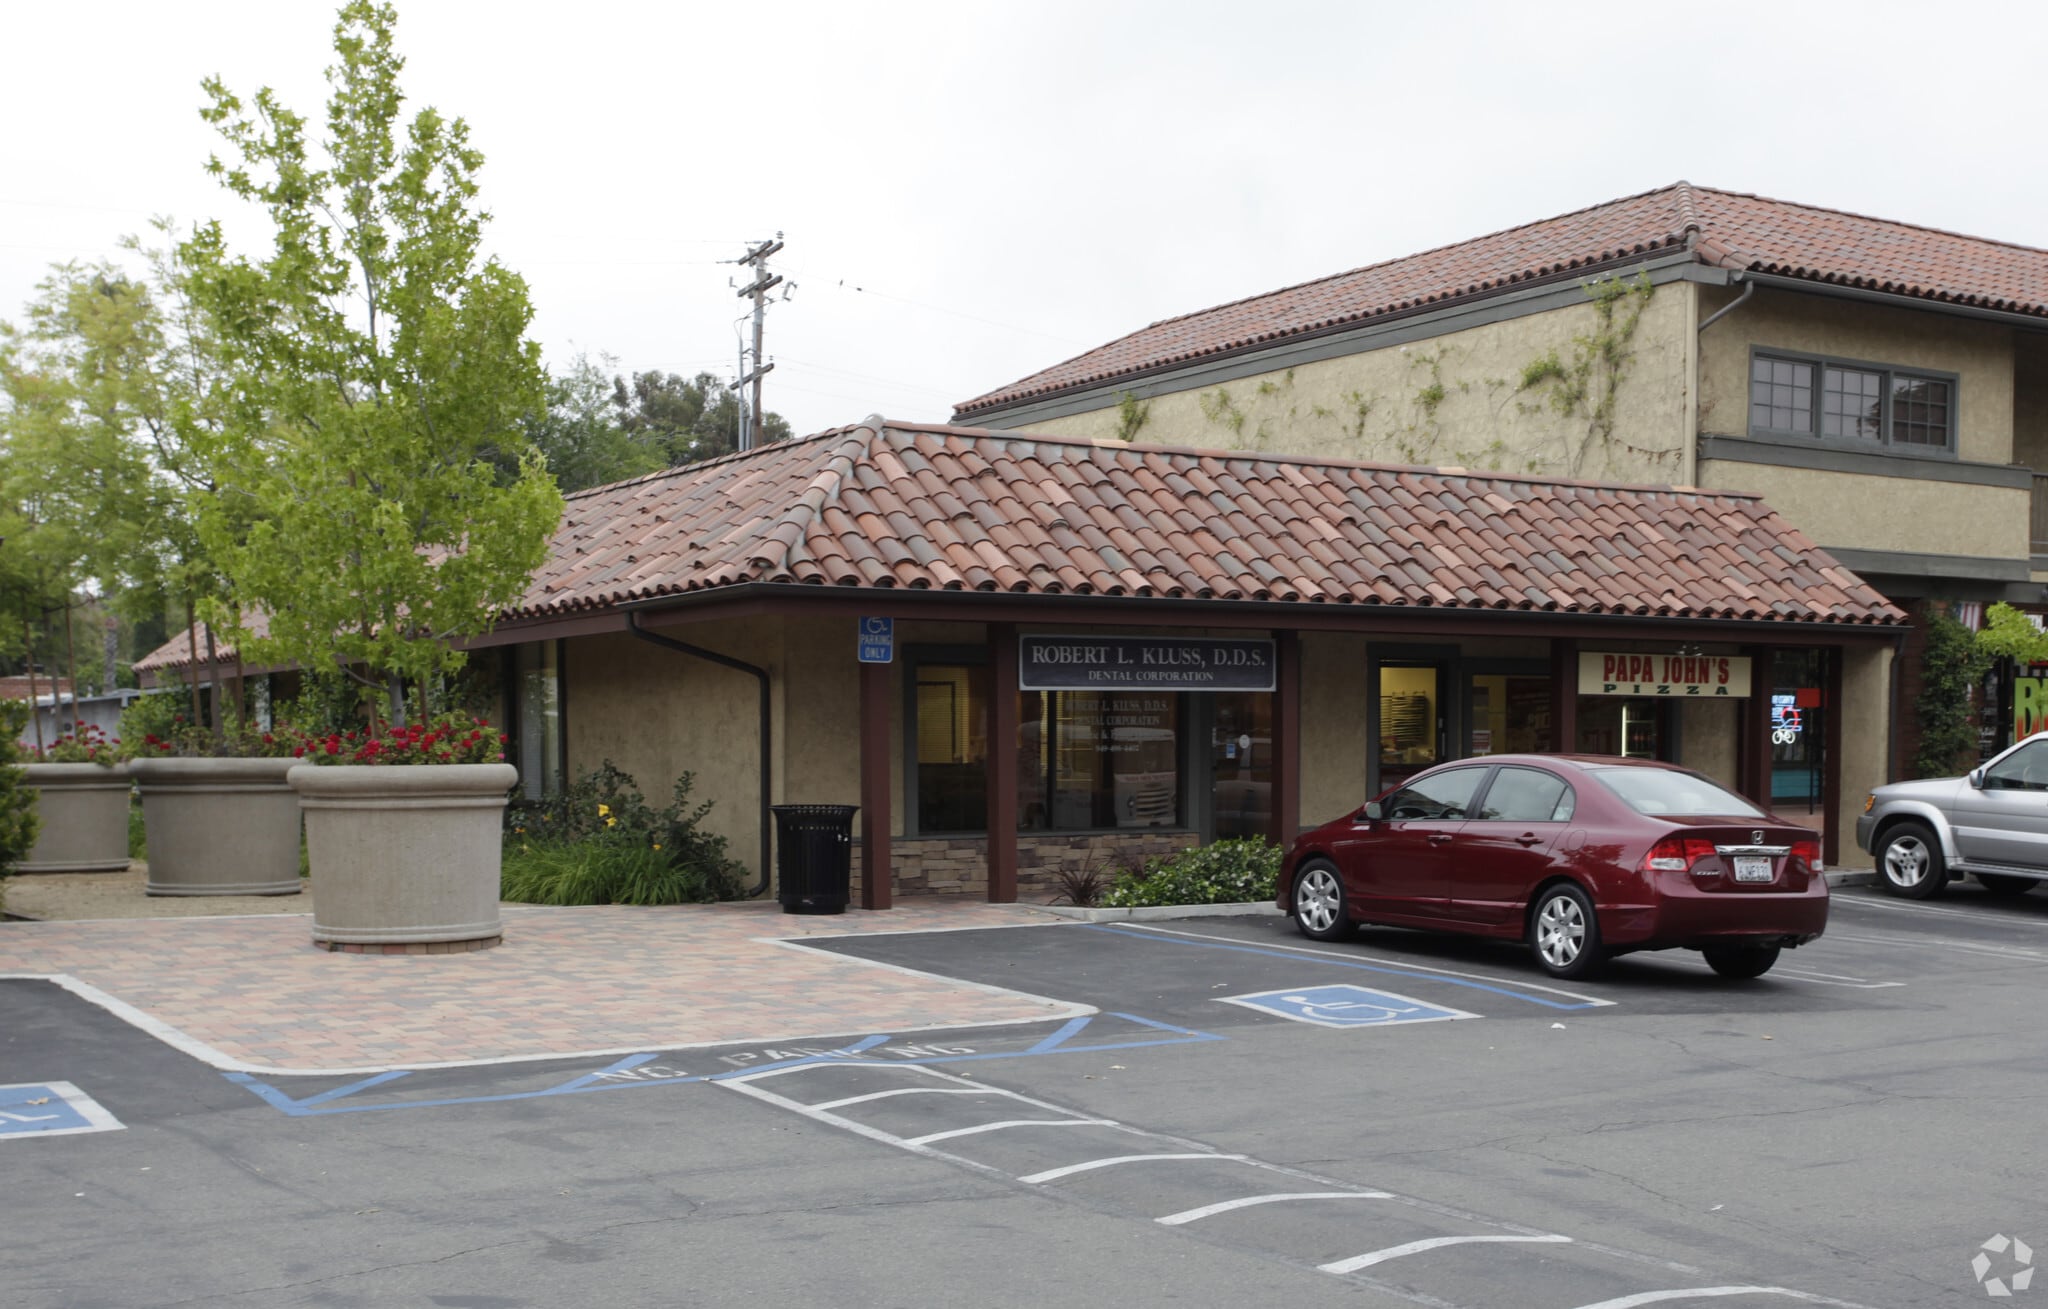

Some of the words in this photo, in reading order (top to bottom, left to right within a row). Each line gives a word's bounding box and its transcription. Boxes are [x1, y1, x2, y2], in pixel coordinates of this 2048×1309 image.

[860, 634, 891, 645] PARKING
[865, 647, 886, 658] ONLY
[1031, 645, 1110, 664] ROBERT
[1117, 646, 1134, 665] L.
[1142, 647, 1206, 669] KLUSS,
[1213, 648, 1266, 667] D.D.S.
[1603, 654, 1654, 683] PAPA
[1662, 656, 1730, 684] JOHN'S
[1087, 670, 1133, 681] DENTAL
[1136, 671, 1214, 682] CORPORATION
[1603, 684, 1729, 695] PIZZA
[718, 1044, 976, 1067] PARKNG
